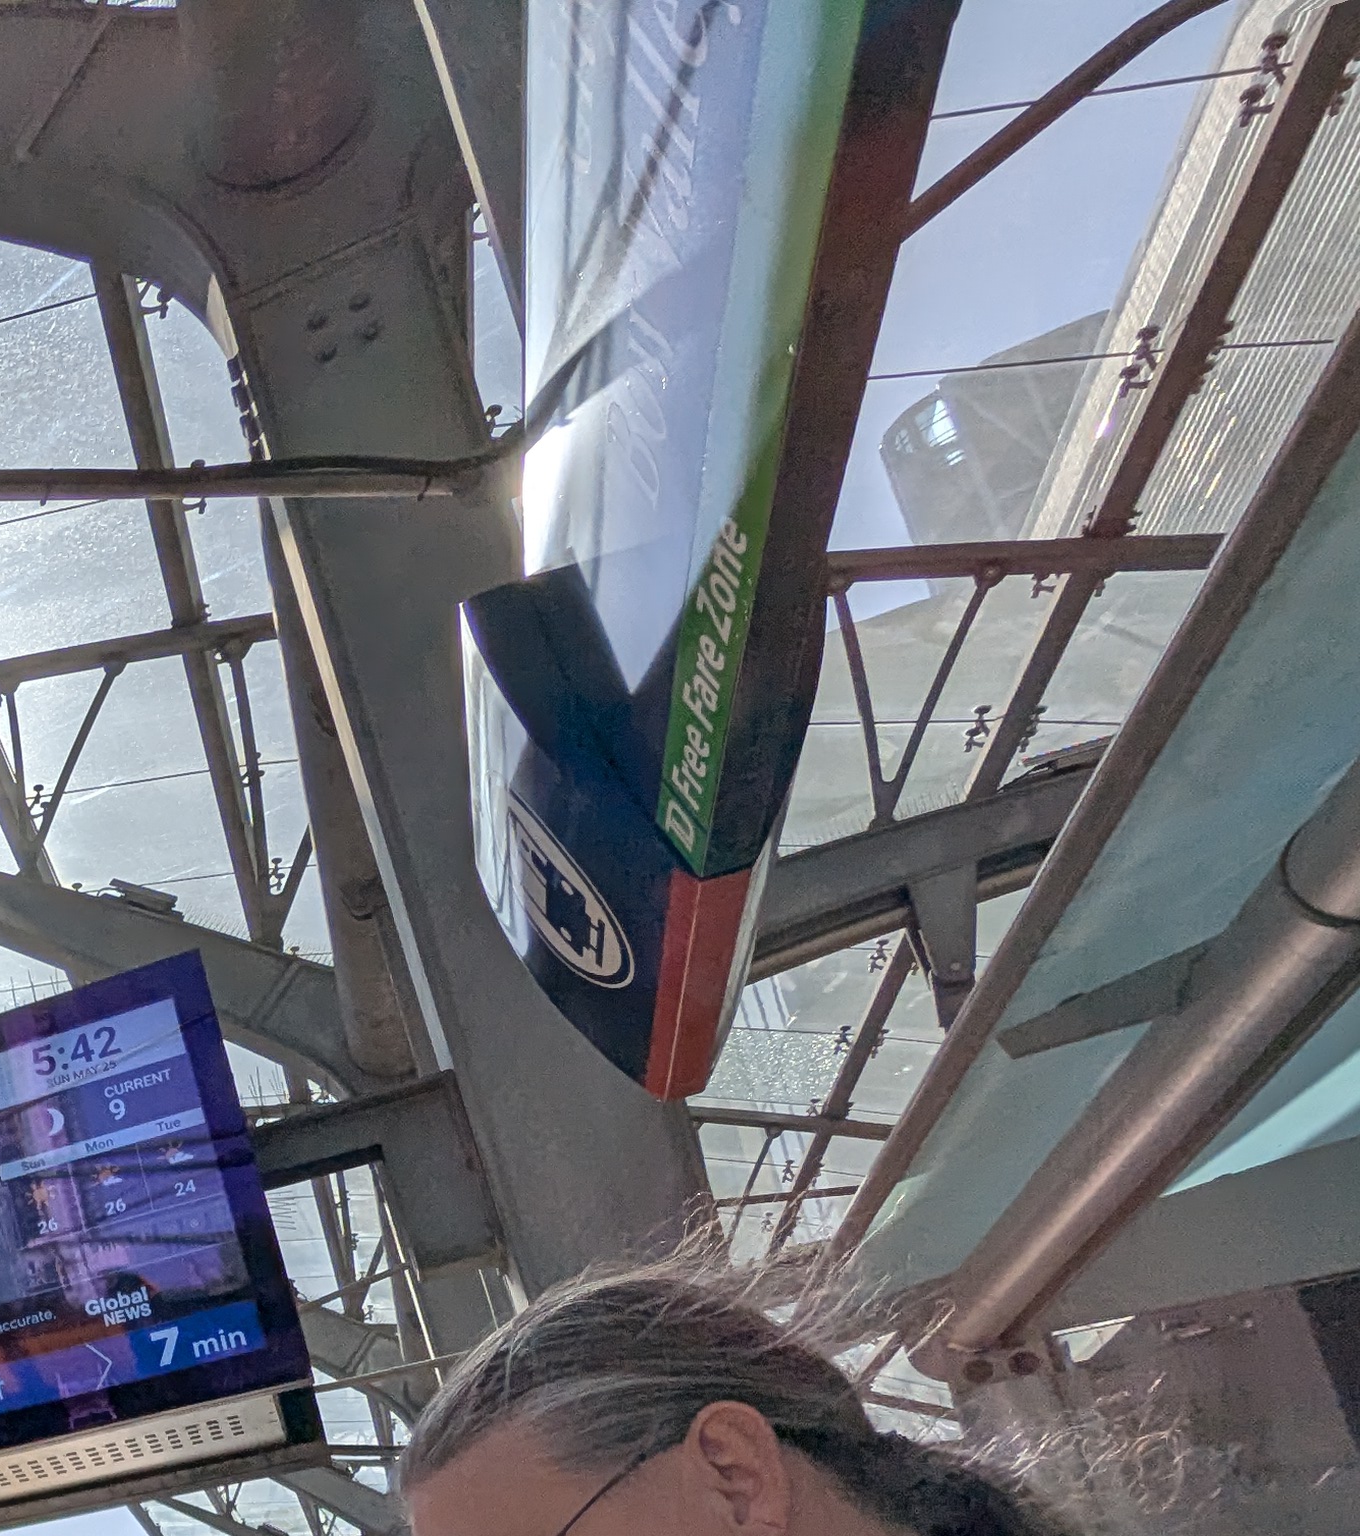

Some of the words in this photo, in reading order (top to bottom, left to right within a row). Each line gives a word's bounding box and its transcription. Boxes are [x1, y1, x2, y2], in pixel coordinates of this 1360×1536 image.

[696, 518, 748, 646] Zone
[682, 633, 726, 733] Fare
[671, 724, 710, 811] Free
[32, 1026, 122, 1076] 5:42
[47, 1074, 71, 1088] SUN
[73, 1065, 100, 1081] MAY
[102, 1059, 118, 1072] 25
[103, 1068, 172, 1099] CURRENT
[108, 1099, 127, 1121] 9
[20, 1157, 46, 1171] Sun
[84, 1136, 115, 1154] Mon
[155, 1116, 182, 1132] Tue
[36, 1220, 59, 1235] 26
[103, 1197, 127, 1217] 26
[173, 1179, 196, 1197] 24
[85, 1286, 150, 1317] Global
[103, 1302, 153, 1328] NEWS
[150, 1326, 179, 1367] 7
[192, 1327, 247, 1359] min
